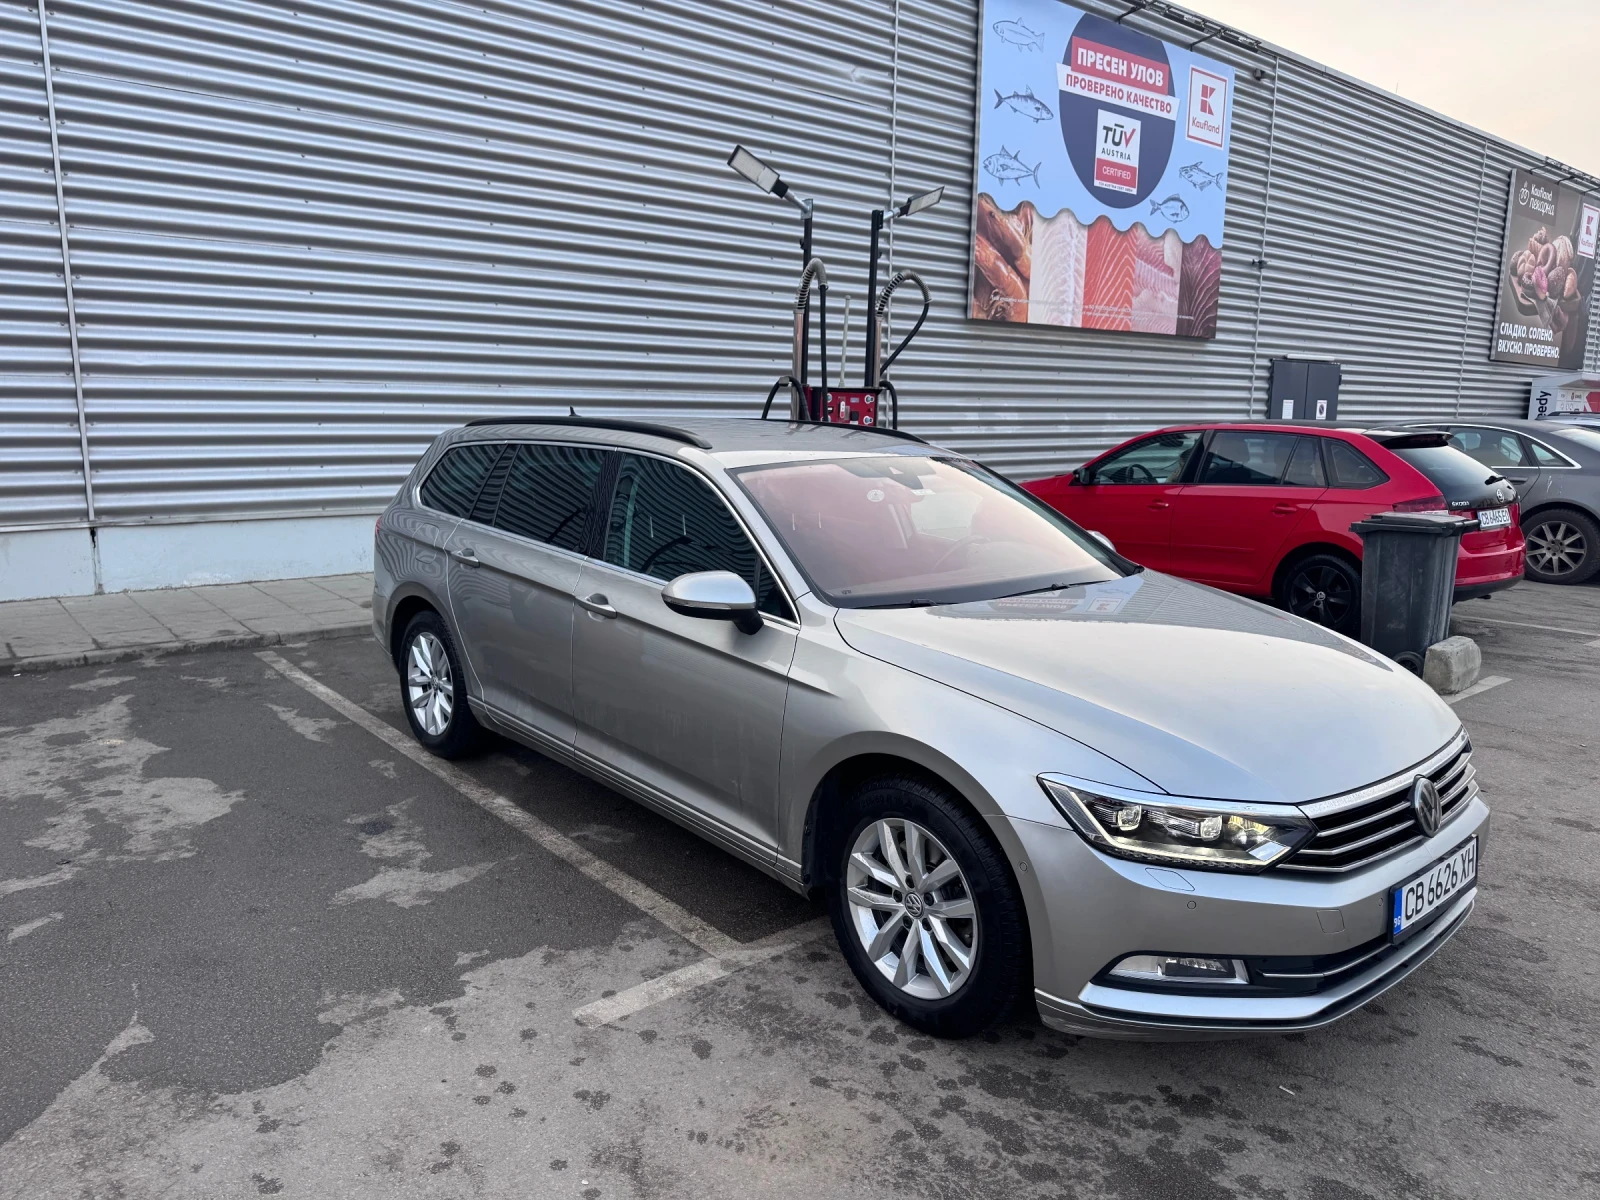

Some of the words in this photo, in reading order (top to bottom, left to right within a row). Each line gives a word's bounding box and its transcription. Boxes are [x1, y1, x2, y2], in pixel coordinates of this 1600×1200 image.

[1077, 47, 1127, 77] ПРЕСЕН
[1130, 62, 1163, 87] УЛОВ
[1066, 73, 1124, 101] ПРОВЕРЕНО
[1126, 91, 1172, 114] КАЧЕСТВО
[1191, 116, 1220, 134] Kaufland
[1101, 147, 1131, 161] AUSTRIA
[1102, 165, 1131, 180] CERTIFIED
[1531, 183, 1553, 202] Kaufland
[1500, 322, 1528, 339] СЛАДКО.
[1528, 326, 1554, 342] СОЛЕНО.
[1497, 339, 1523, 354] ВКУСНО.
[1524, 343, 1560, 359] ПРОВЕРЕНО.
[1481, 512, 1490, 526] CB
[1405, 881, 1425, 921] CB
[1427, 857, 1458, 906] 6626
[1460, 844, 1475, 883] XH
